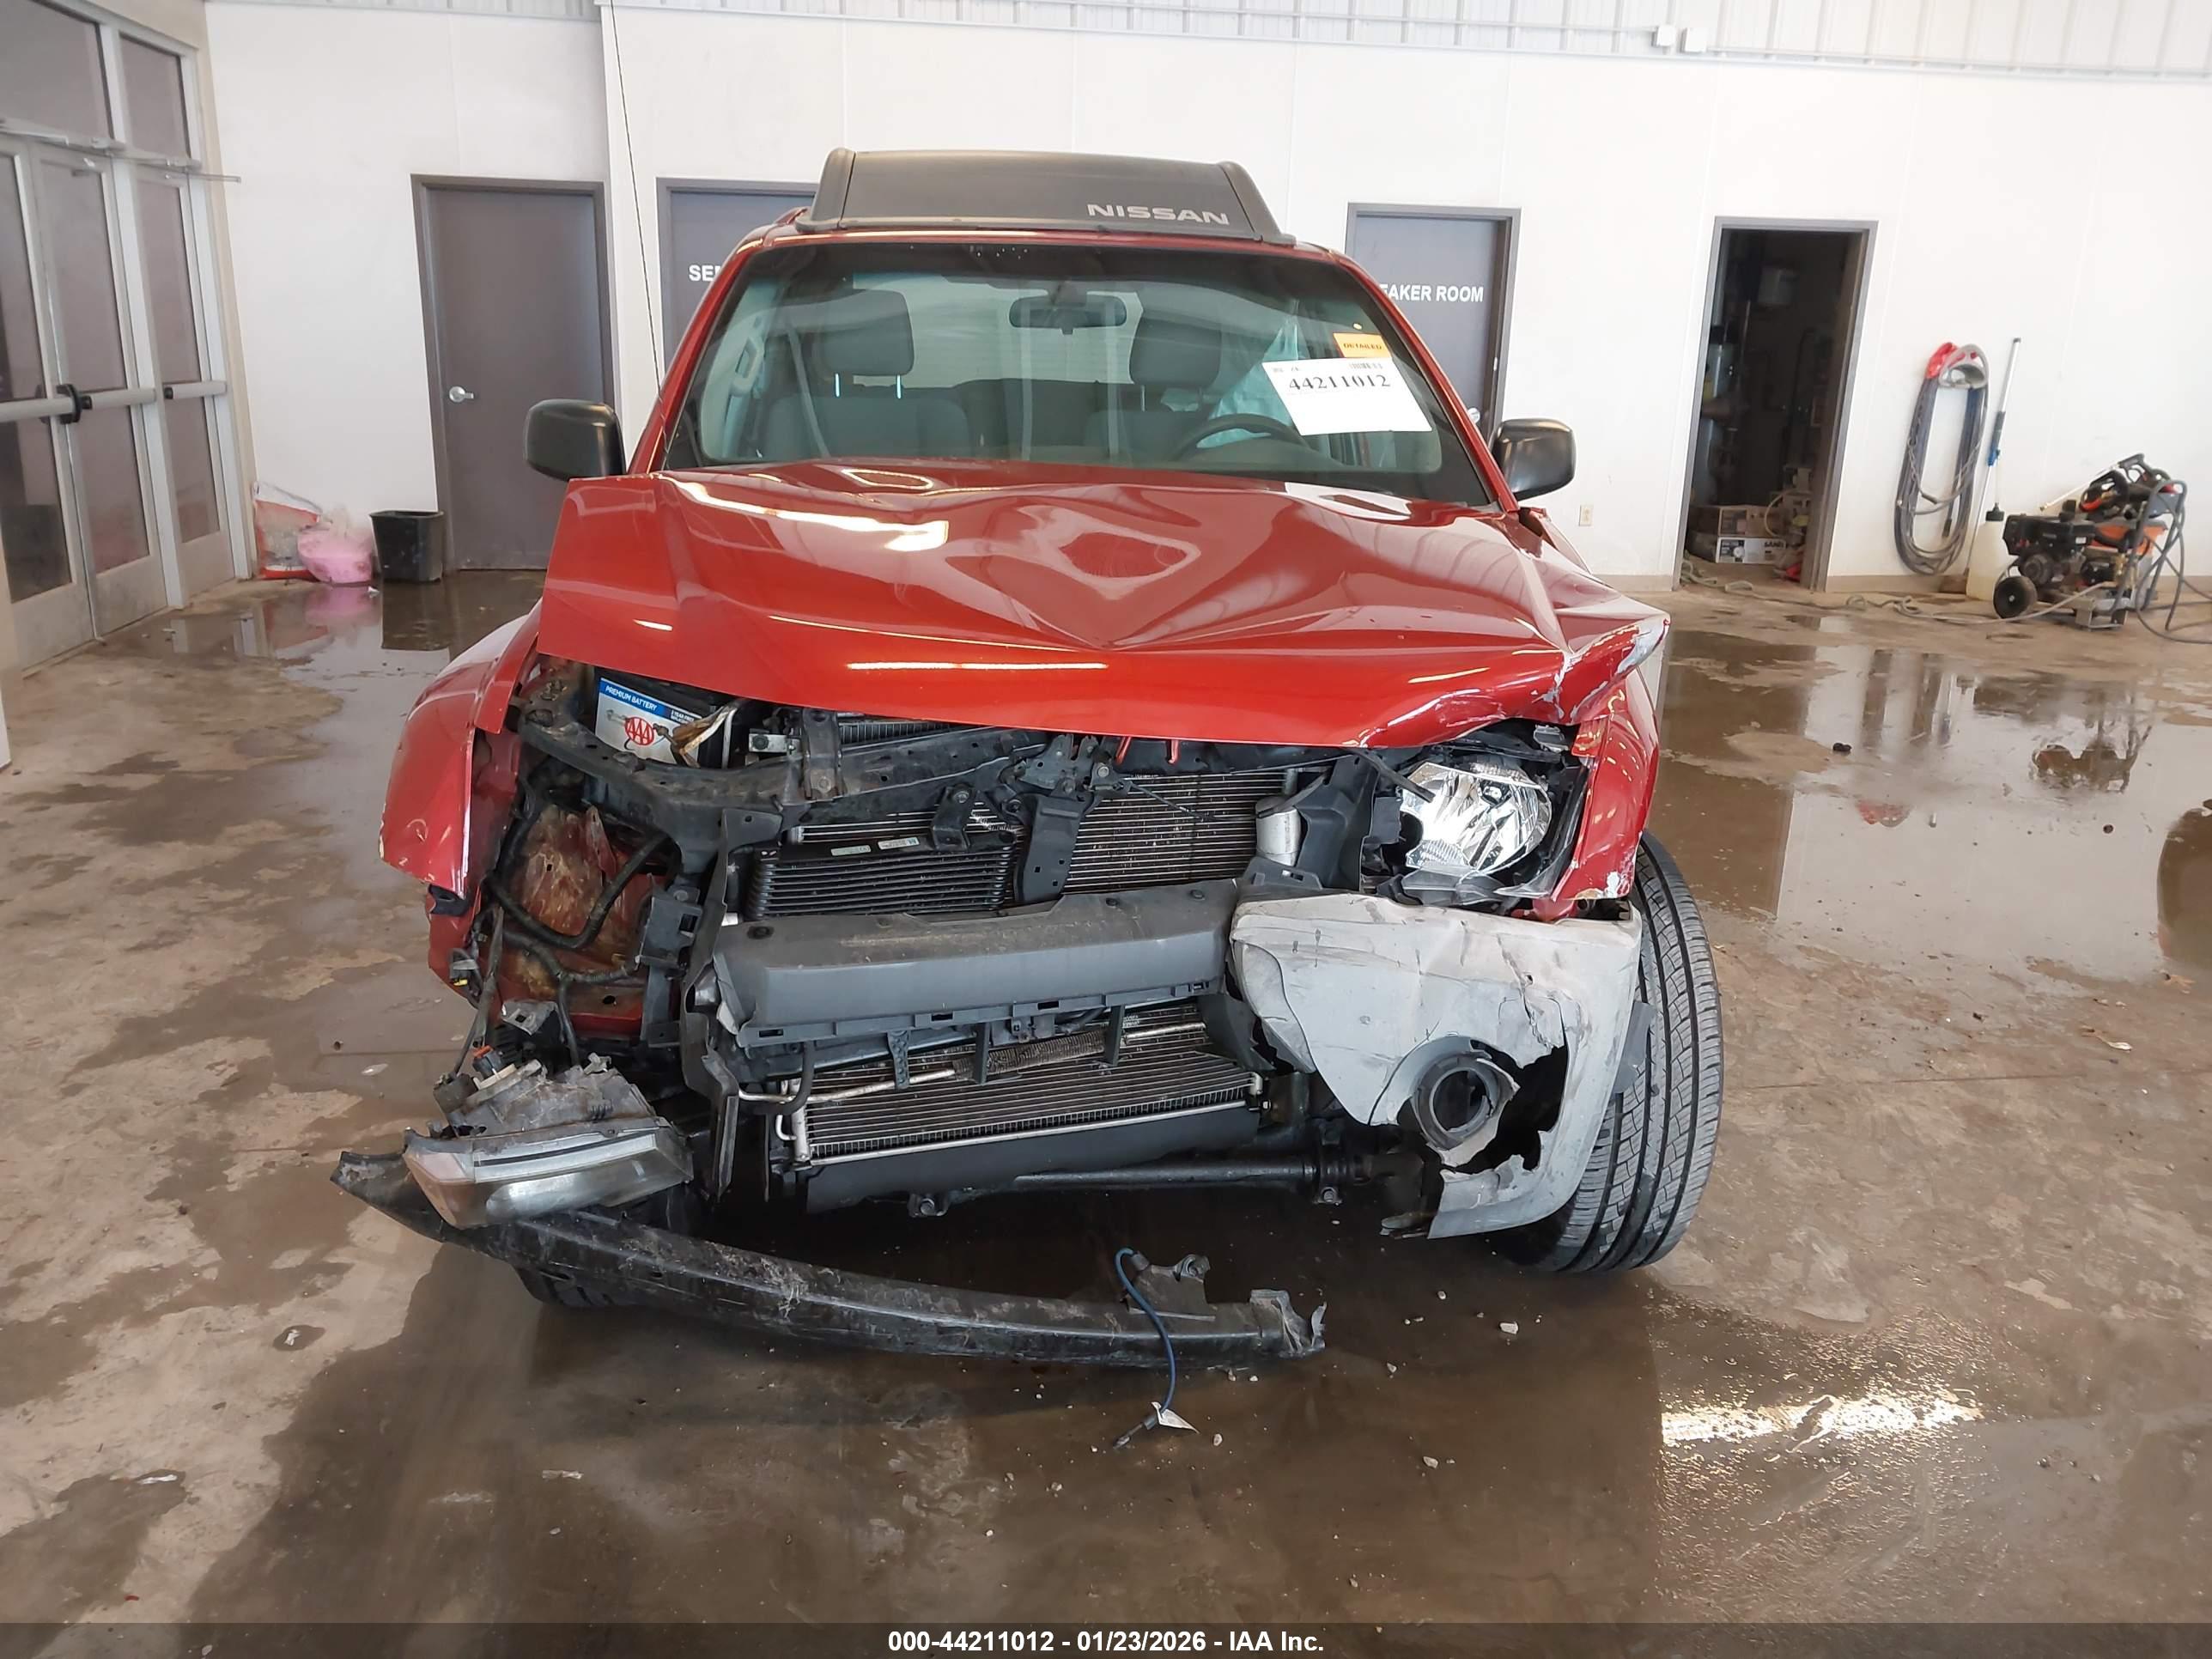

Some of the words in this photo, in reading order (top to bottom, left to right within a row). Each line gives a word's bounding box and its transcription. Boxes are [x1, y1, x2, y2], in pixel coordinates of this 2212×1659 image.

[1087, 204, 1230, 225] NISSAN
[1436, 285, 1484, 302] ROOM
[1289, 374, 1391, 391] 44211012
[605, 685, 631, 702] PREMIUM
[631, 696, 658, 711] BATTERY
[626, 718, 653, 744] AAA
